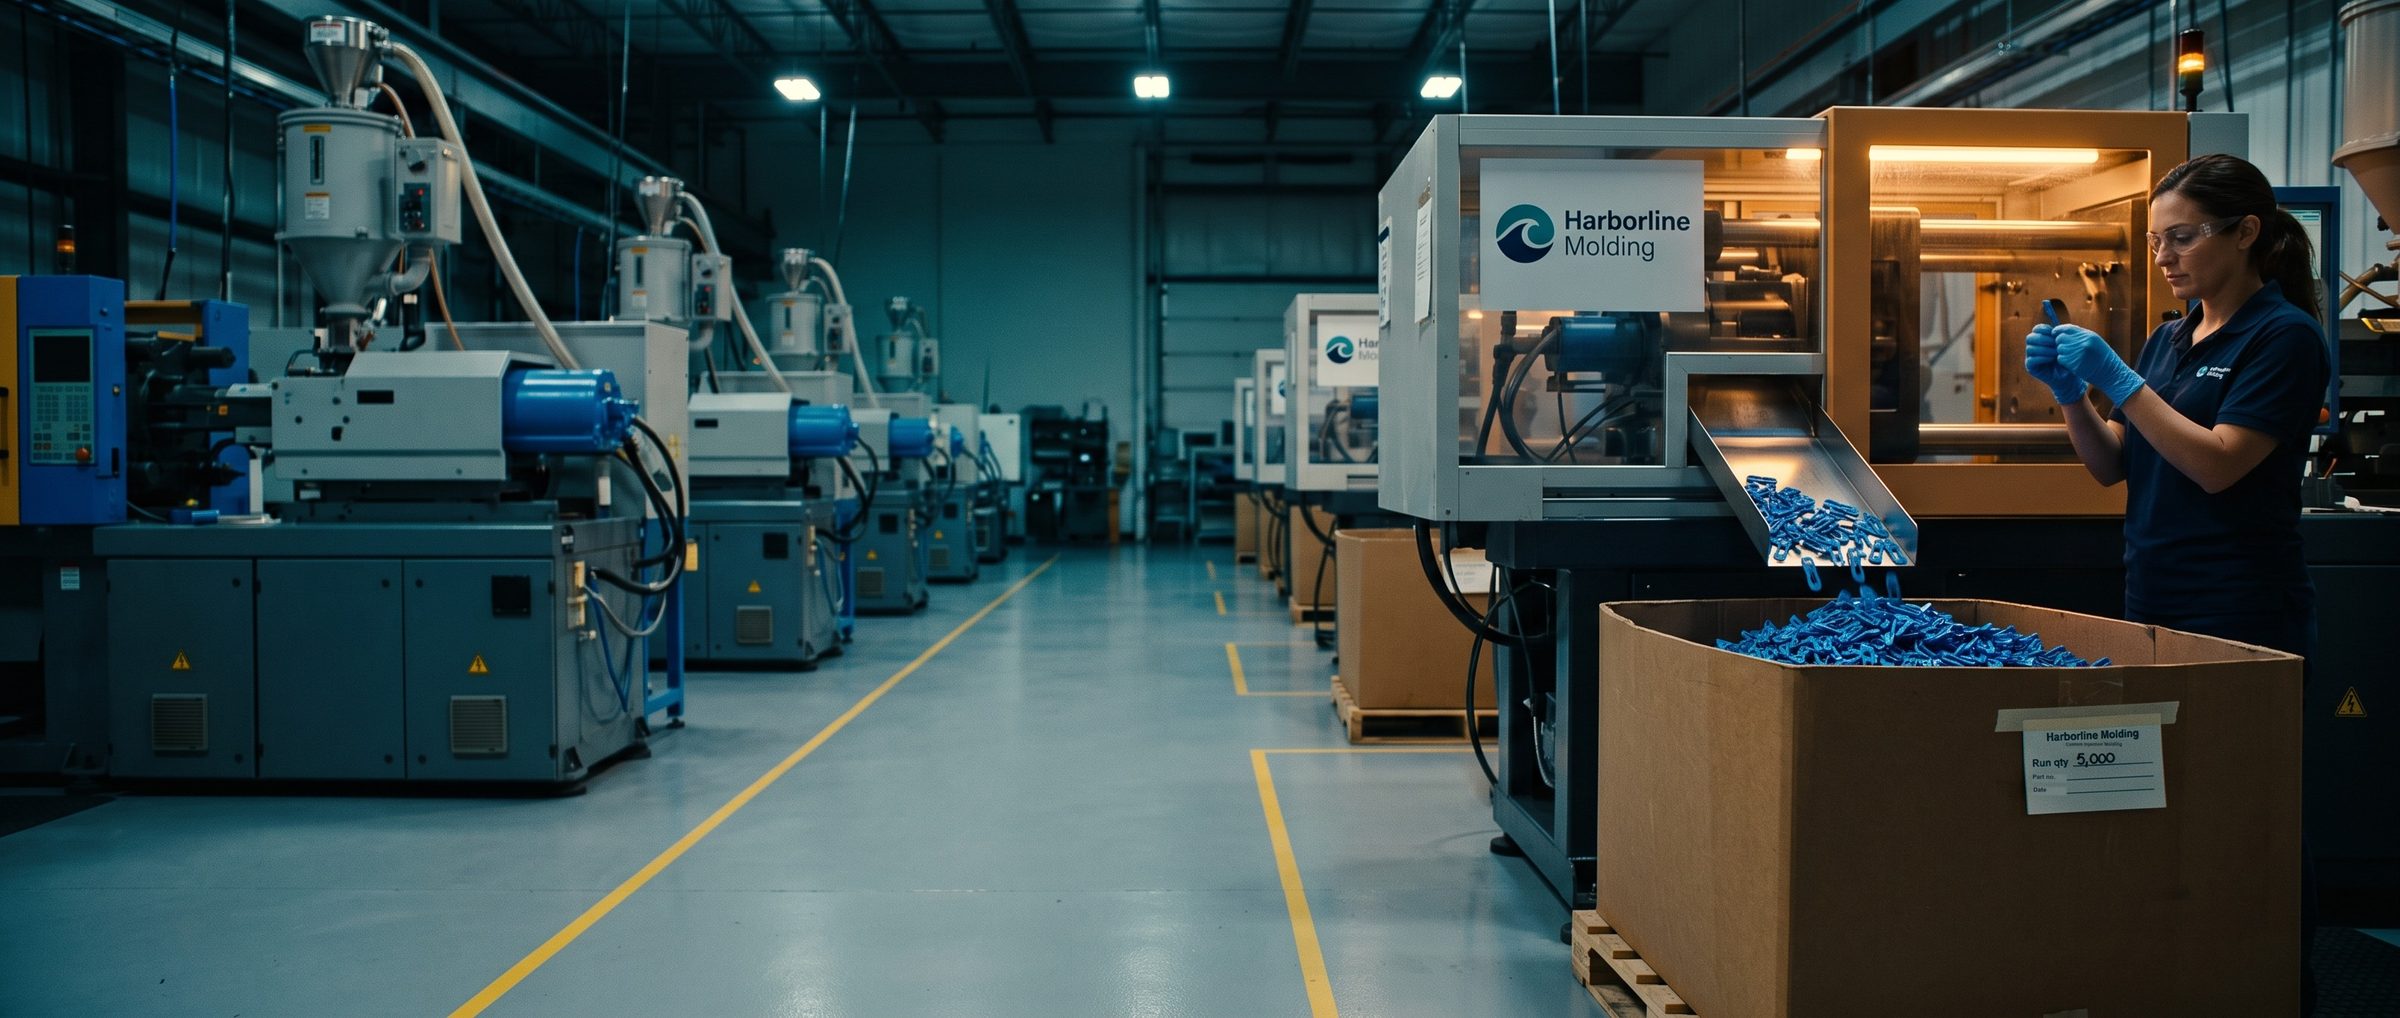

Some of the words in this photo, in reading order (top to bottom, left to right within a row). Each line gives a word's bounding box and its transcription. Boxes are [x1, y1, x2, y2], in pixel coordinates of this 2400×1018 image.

[1565, 210, 1690, 231] Harborline
[1565, 235, 1655, 262] Molding
[2046, 731, 2098, 742] Harborline
[2100, 729, 2139, 740] Molding
[2032, 758, 2052, 768] Run
[2053, 758, 2069, 769] qty
[2076, 752, 2116, 768] 5,000
